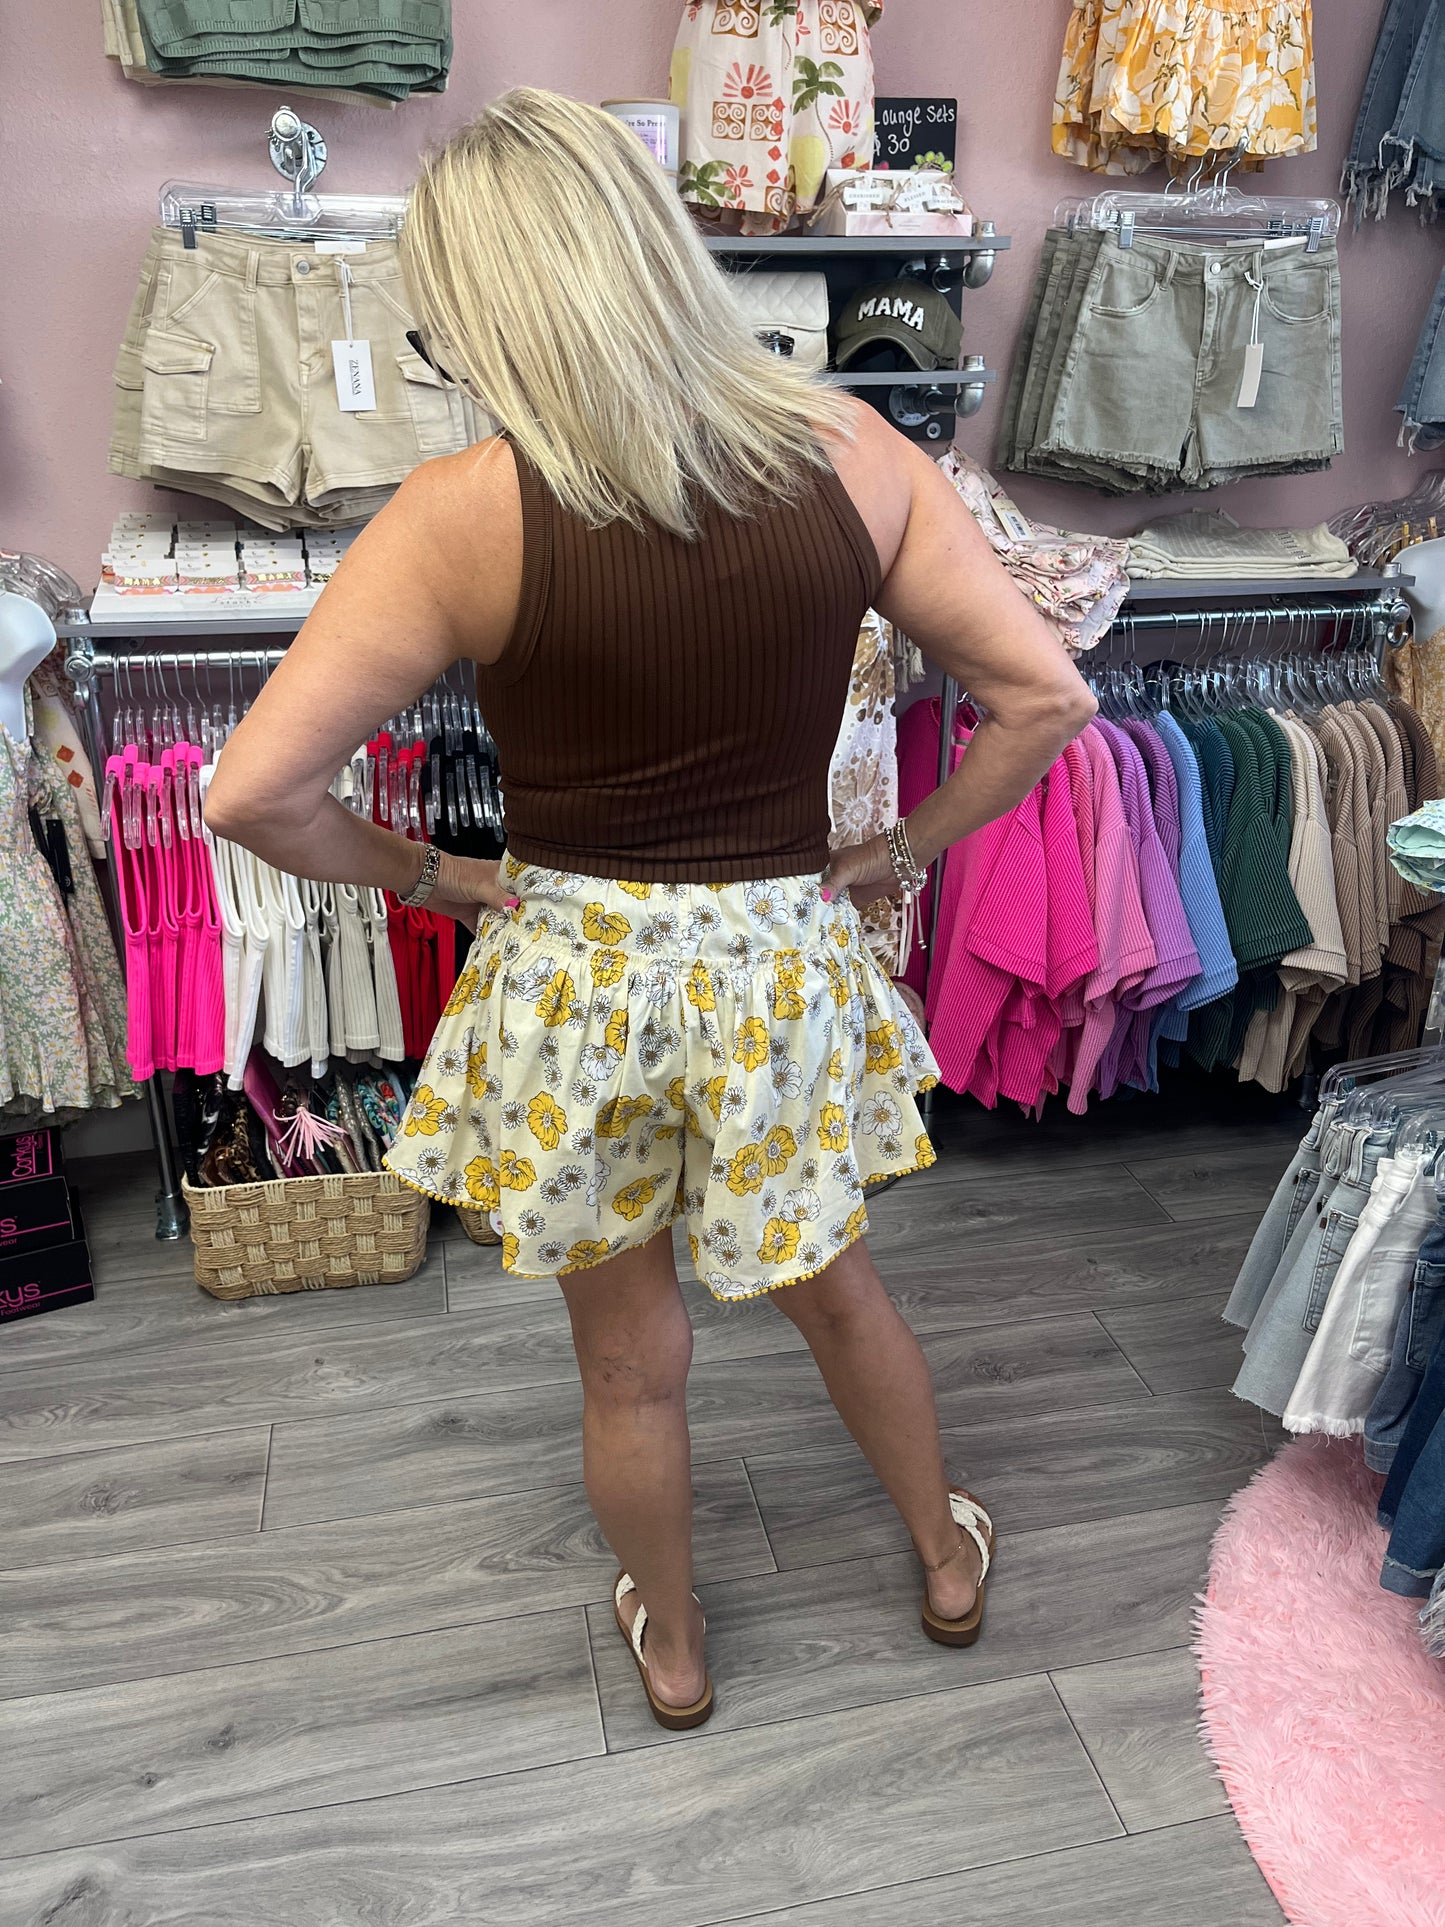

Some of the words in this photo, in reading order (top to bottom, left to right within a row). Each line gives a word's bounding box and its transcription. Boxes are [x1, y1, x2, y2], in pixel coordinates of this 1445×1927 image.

[926, 104, 956, 123] Sets
[887, 133, 910, 155] 30
[857, 296, 925, 332] MAMA
[352, 359, 362, 396] ZENANA
[10, 1135, 37, 1177] Corkys
